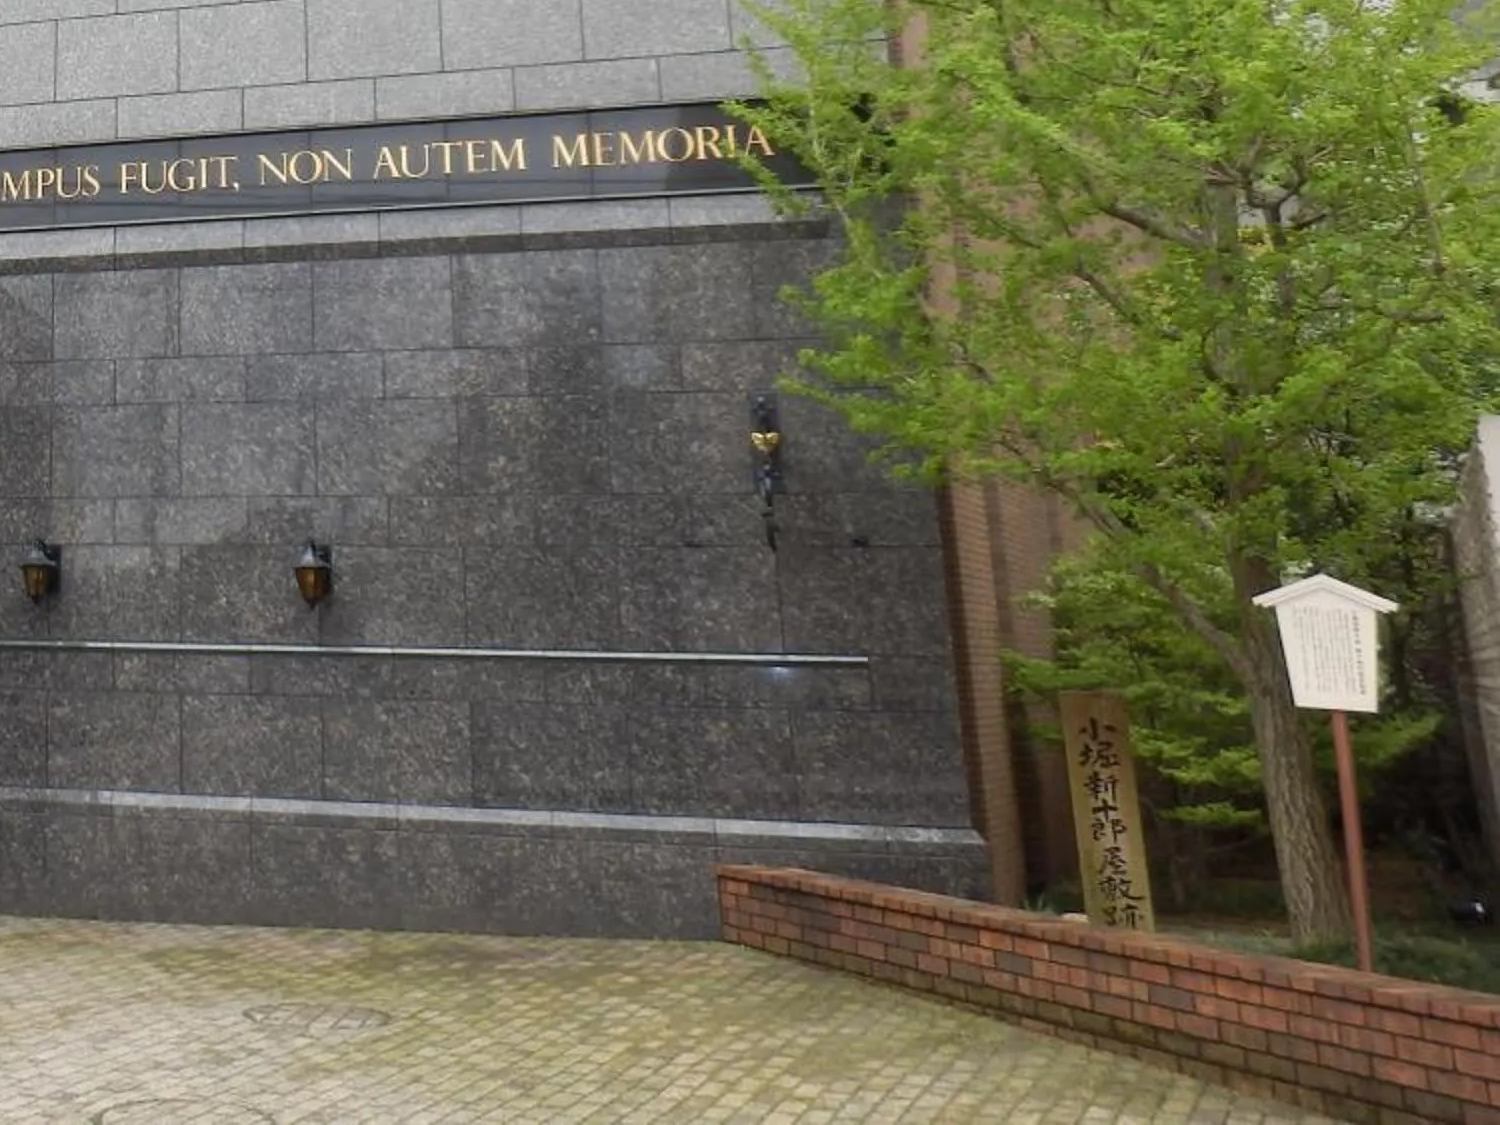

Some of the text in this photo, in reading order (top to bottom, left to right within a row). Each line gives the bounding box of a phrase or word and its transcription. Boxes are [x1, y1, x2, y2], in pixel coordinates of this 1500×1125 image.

[119, 154, 242, 195] FUGIT,
[257, 148, 353, 185] NON
[372, 138, 527, 180] AUTEM
[551, 125, 775, 166] MEMORIA
